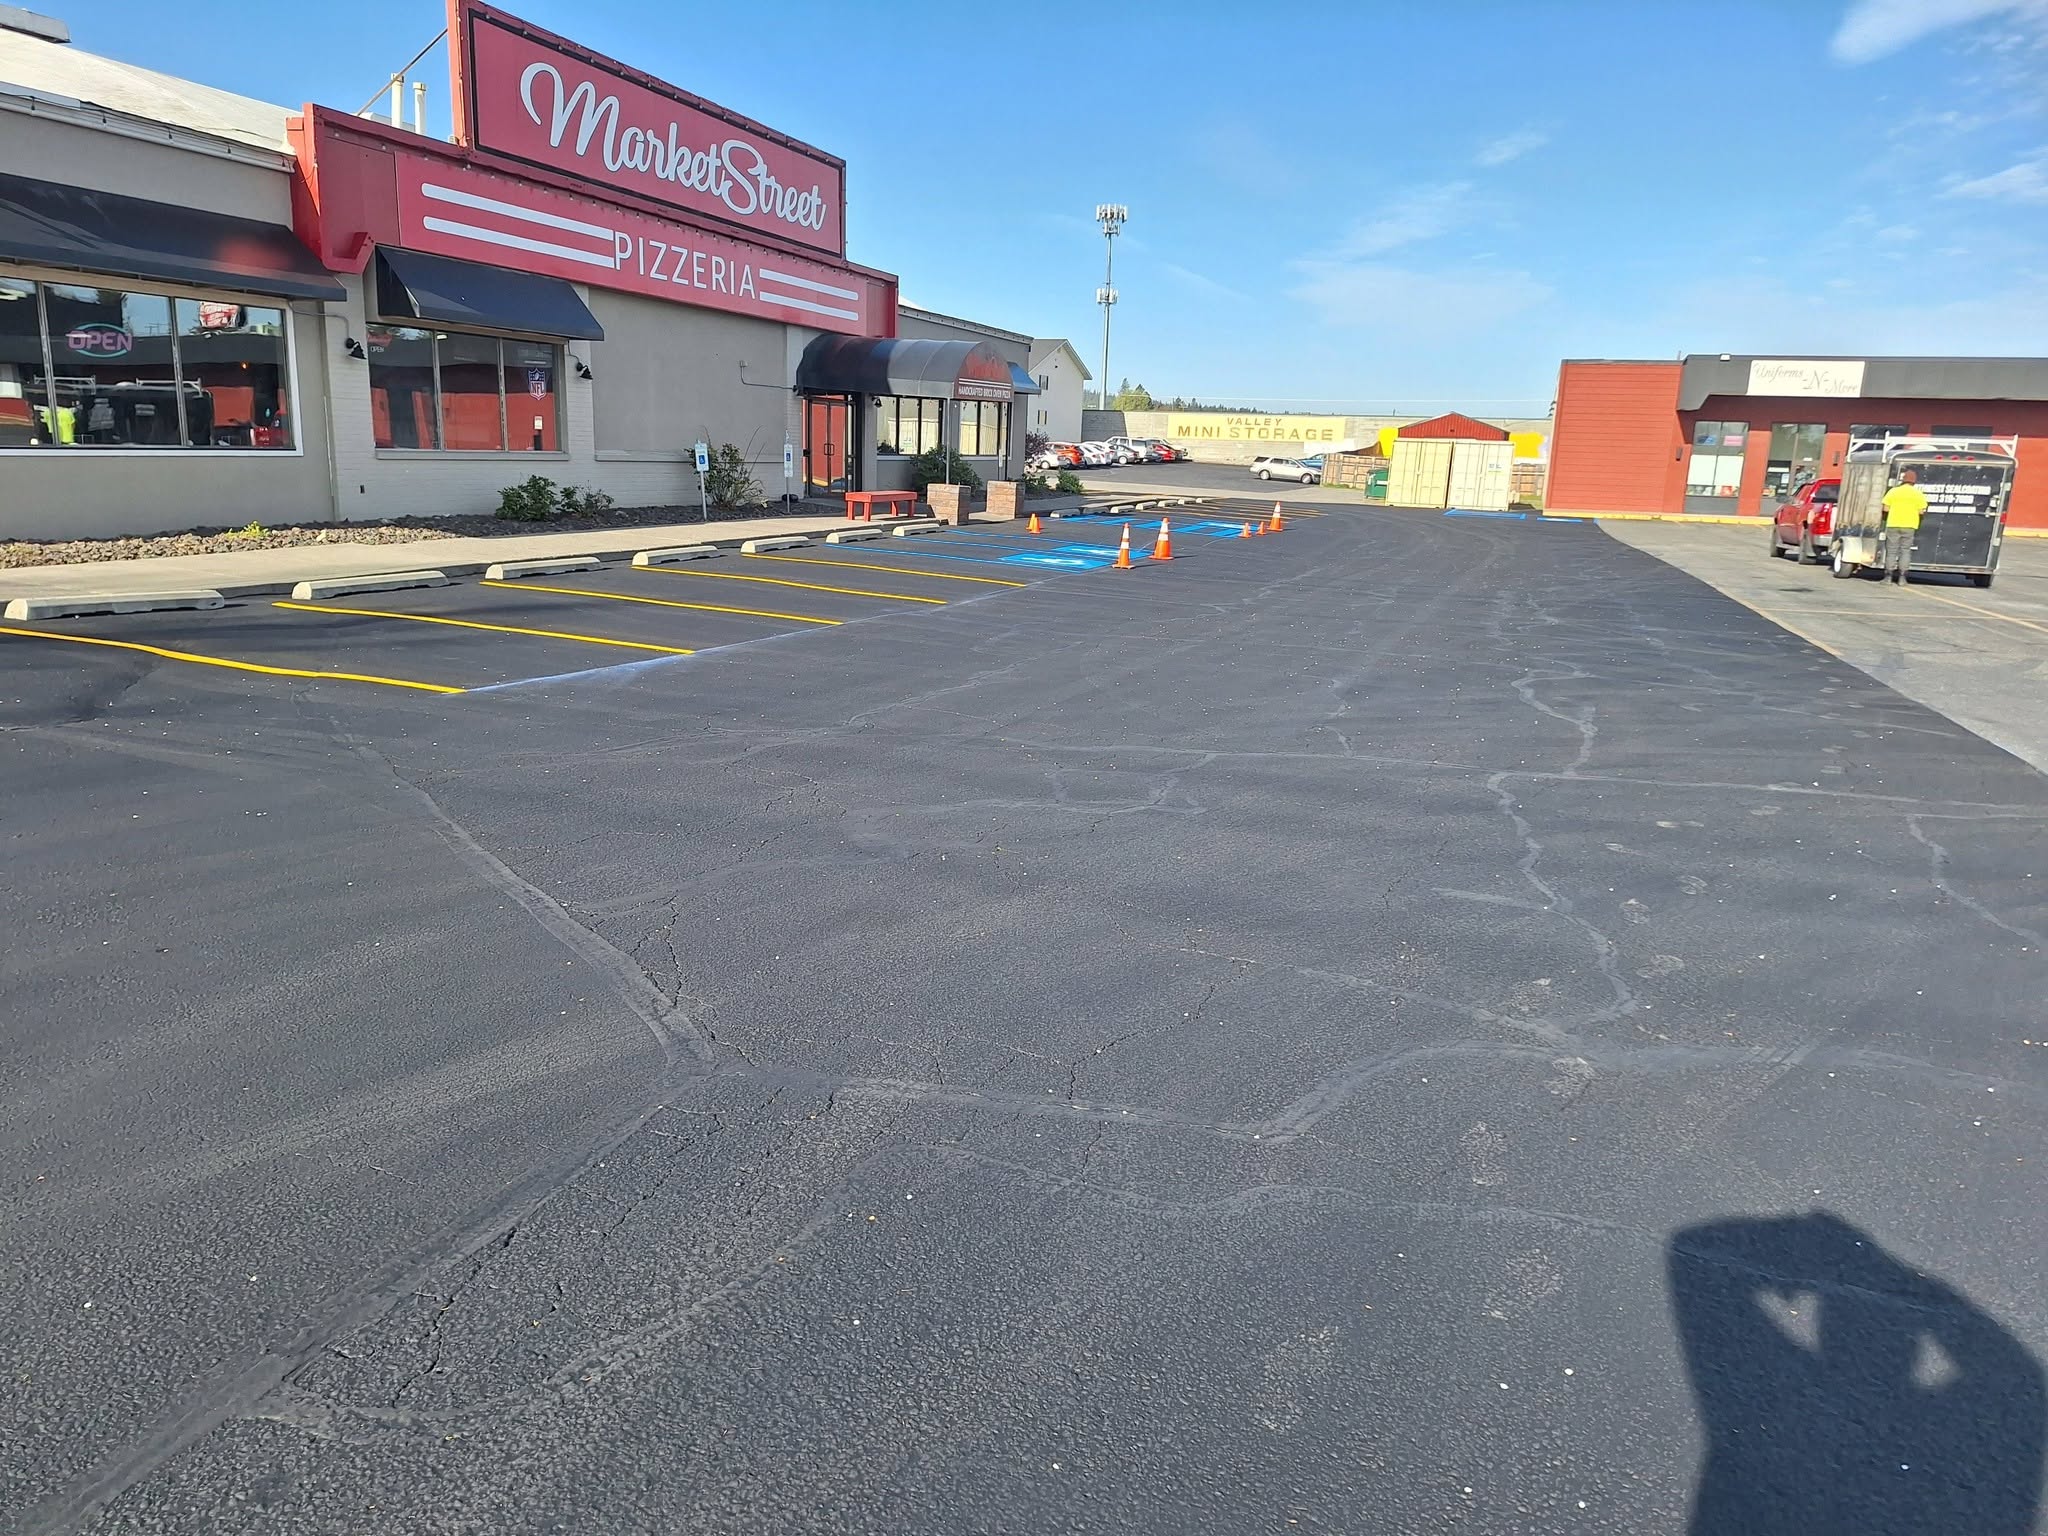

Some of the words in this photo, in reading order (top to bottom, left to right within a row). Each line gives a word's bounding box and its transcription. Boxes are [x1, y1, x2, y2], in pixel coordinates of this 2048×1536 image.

[520, 62, 726, 197] Market
[721, 140, 827, 231] Street
[614, 231, 756, 300] PIZZERIA
[68, 330, 133, 351] OPEN
[1753, 362, 1804, 384] Uniforms
[531, 382, 545, 395] NFL
[1227, 417, 1283, 426] VALLEY
[1177, 425, 1221, 438] MINI
[1228, 427, 1334, 441] STORAGE
